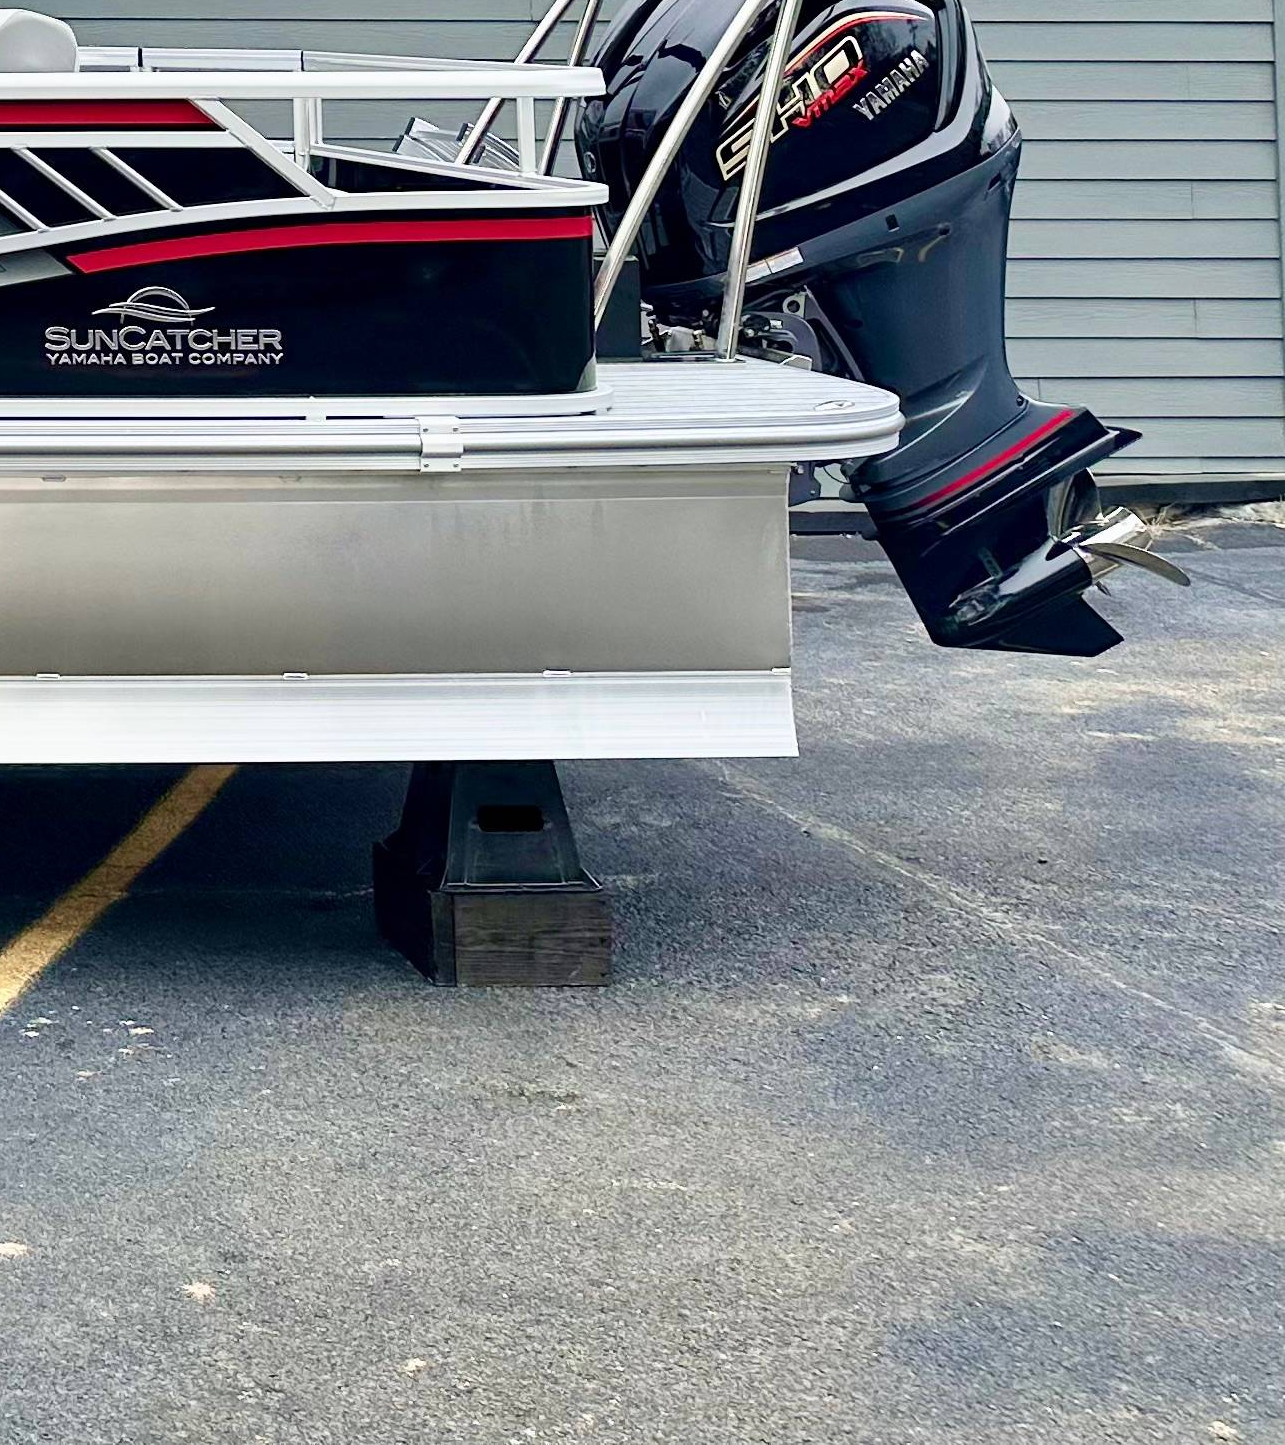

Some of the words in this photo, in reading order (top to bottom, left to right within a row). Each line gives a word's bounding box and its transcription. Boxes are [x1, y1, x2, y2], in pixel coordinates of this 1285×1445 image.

[852, 49, 930, 121] YAMAHA
[46, 353, 127, 365] YAMAHA
[132, 353, 183, 365] BOAT
[188, 353, 283, 365] COMPANY
